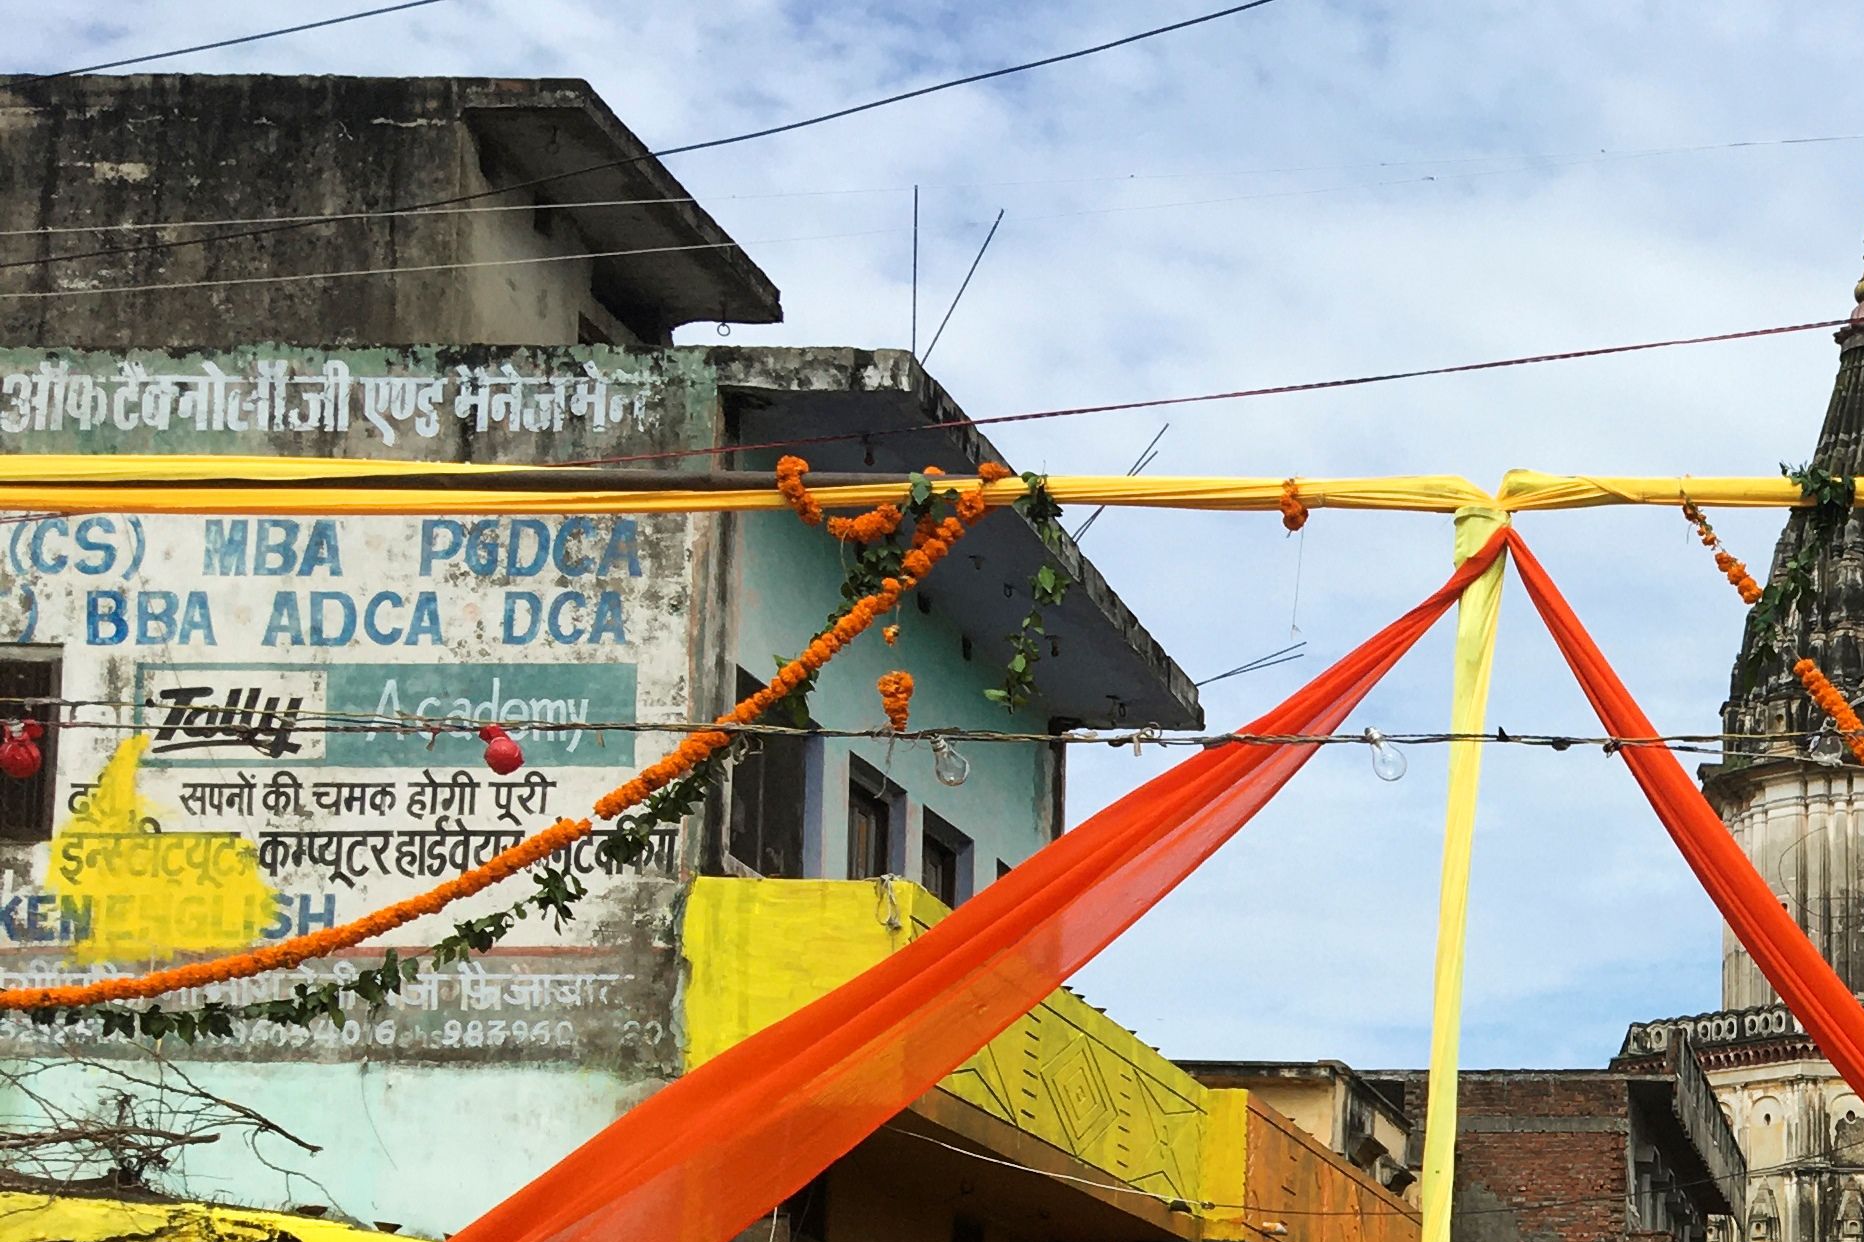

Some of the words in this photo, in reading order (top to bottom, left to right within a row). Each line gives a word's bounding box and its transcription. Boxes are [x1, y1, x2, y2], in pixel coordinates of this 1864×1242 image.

[10, 514, 146, 581] (CS)
[202, 518, 343, 577] MBA
[419, 517, 643, 577] PGDCA
[86, 590, 218, 646] BBA
[261, 590, 445, 647] ADCA
[502, 590, 627, 646] DCA
[153, 685, 304, 759] Tally
[366, 676, 590, 753] Academy
[179, 769, 257, 817] सपनों
[262, 770, 304, 816] की
[312, 780, 396, 817] चमक
[407, 768, 481, 820] होगी
[488, 770, 557, 827] पूरी
[258, 829, 395, 888] कम्प्यूटर
